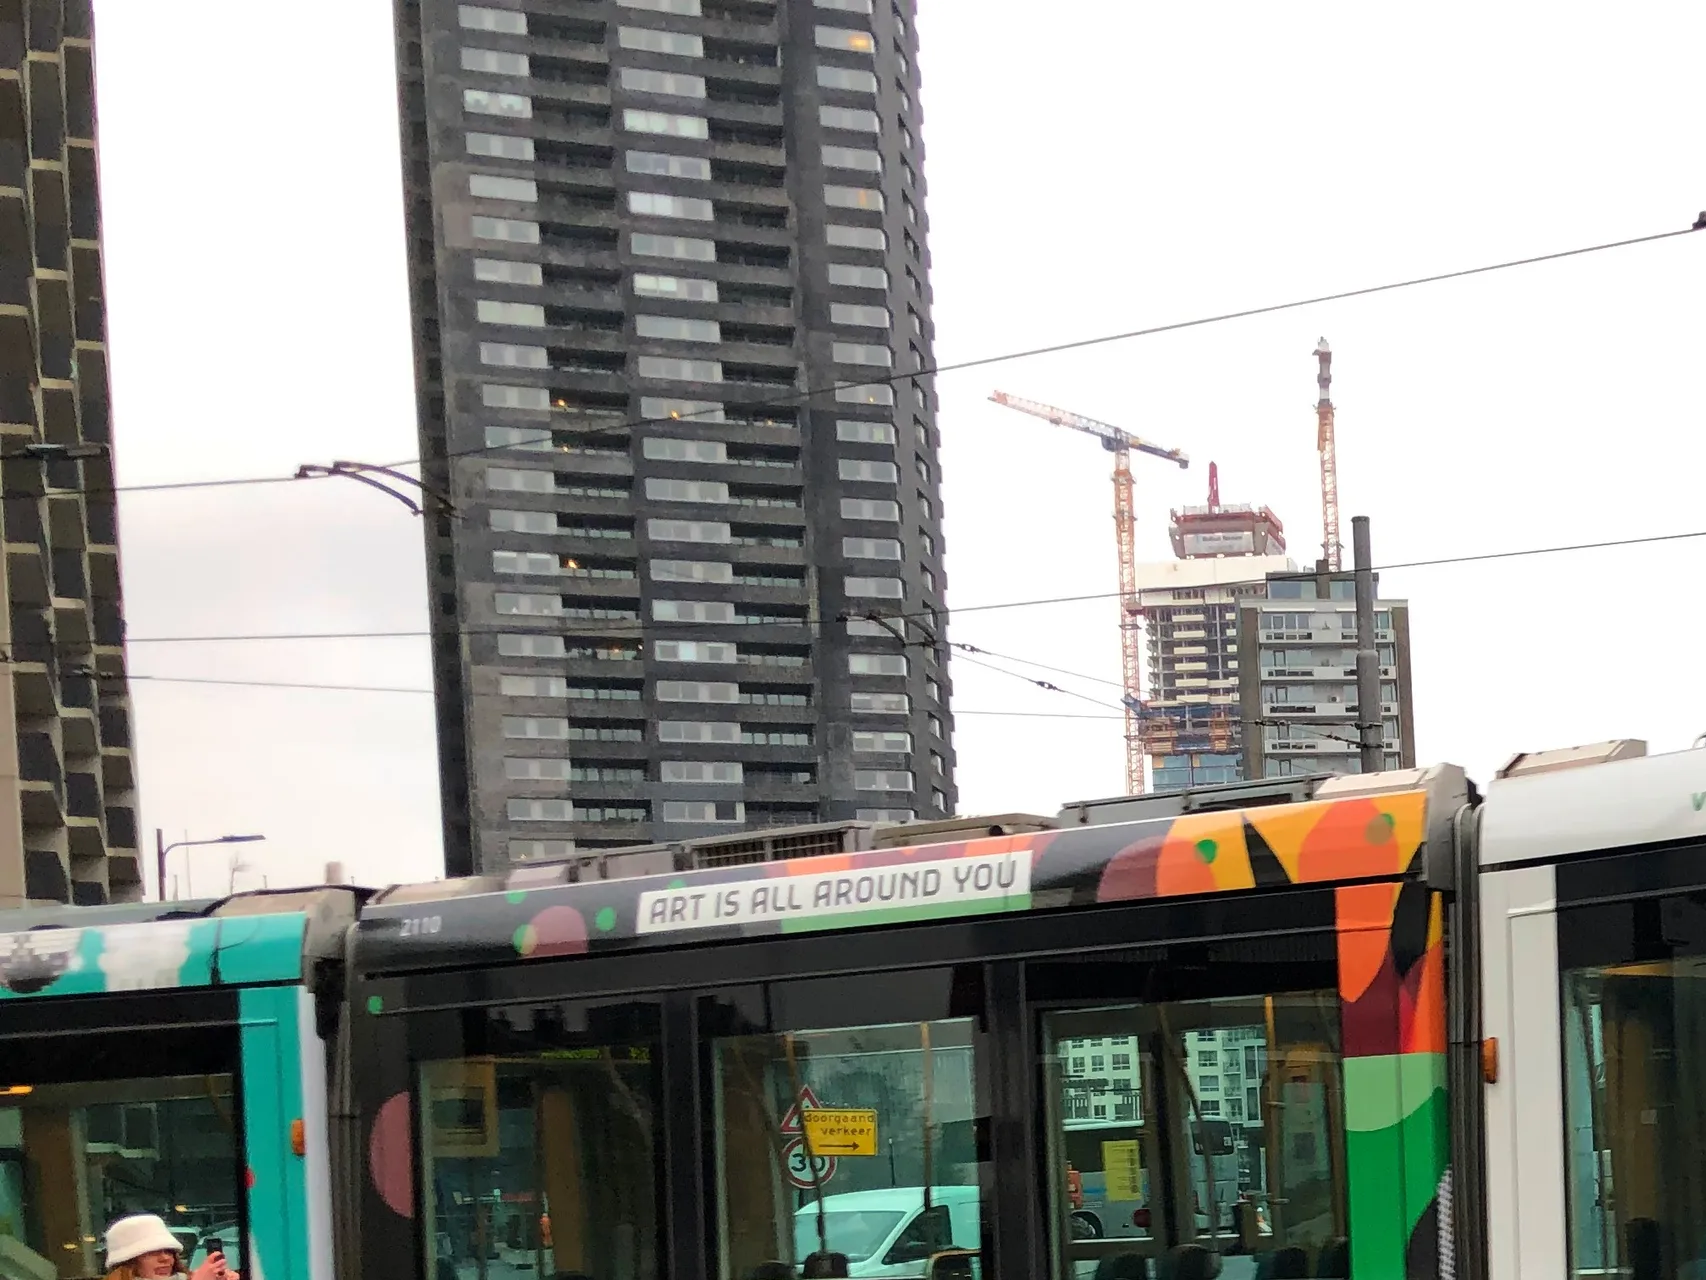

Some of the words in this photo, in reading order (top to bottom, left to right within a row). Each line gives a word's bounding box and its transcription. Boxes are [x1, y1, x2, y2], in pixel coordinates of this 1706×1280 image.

[649, 894, 705, 925] ART
[714, 890, 740, 919] IS
[750, 886, 802, 914] ALL
[812, 868, 941, 908] AROUND
[953, 860, 1017, 894] YOU
[805, 1113, 874, 1124] doorgaand
[821, 1127, 872, 1136] verkeer
[791, 1152, 826, 1172] 30
